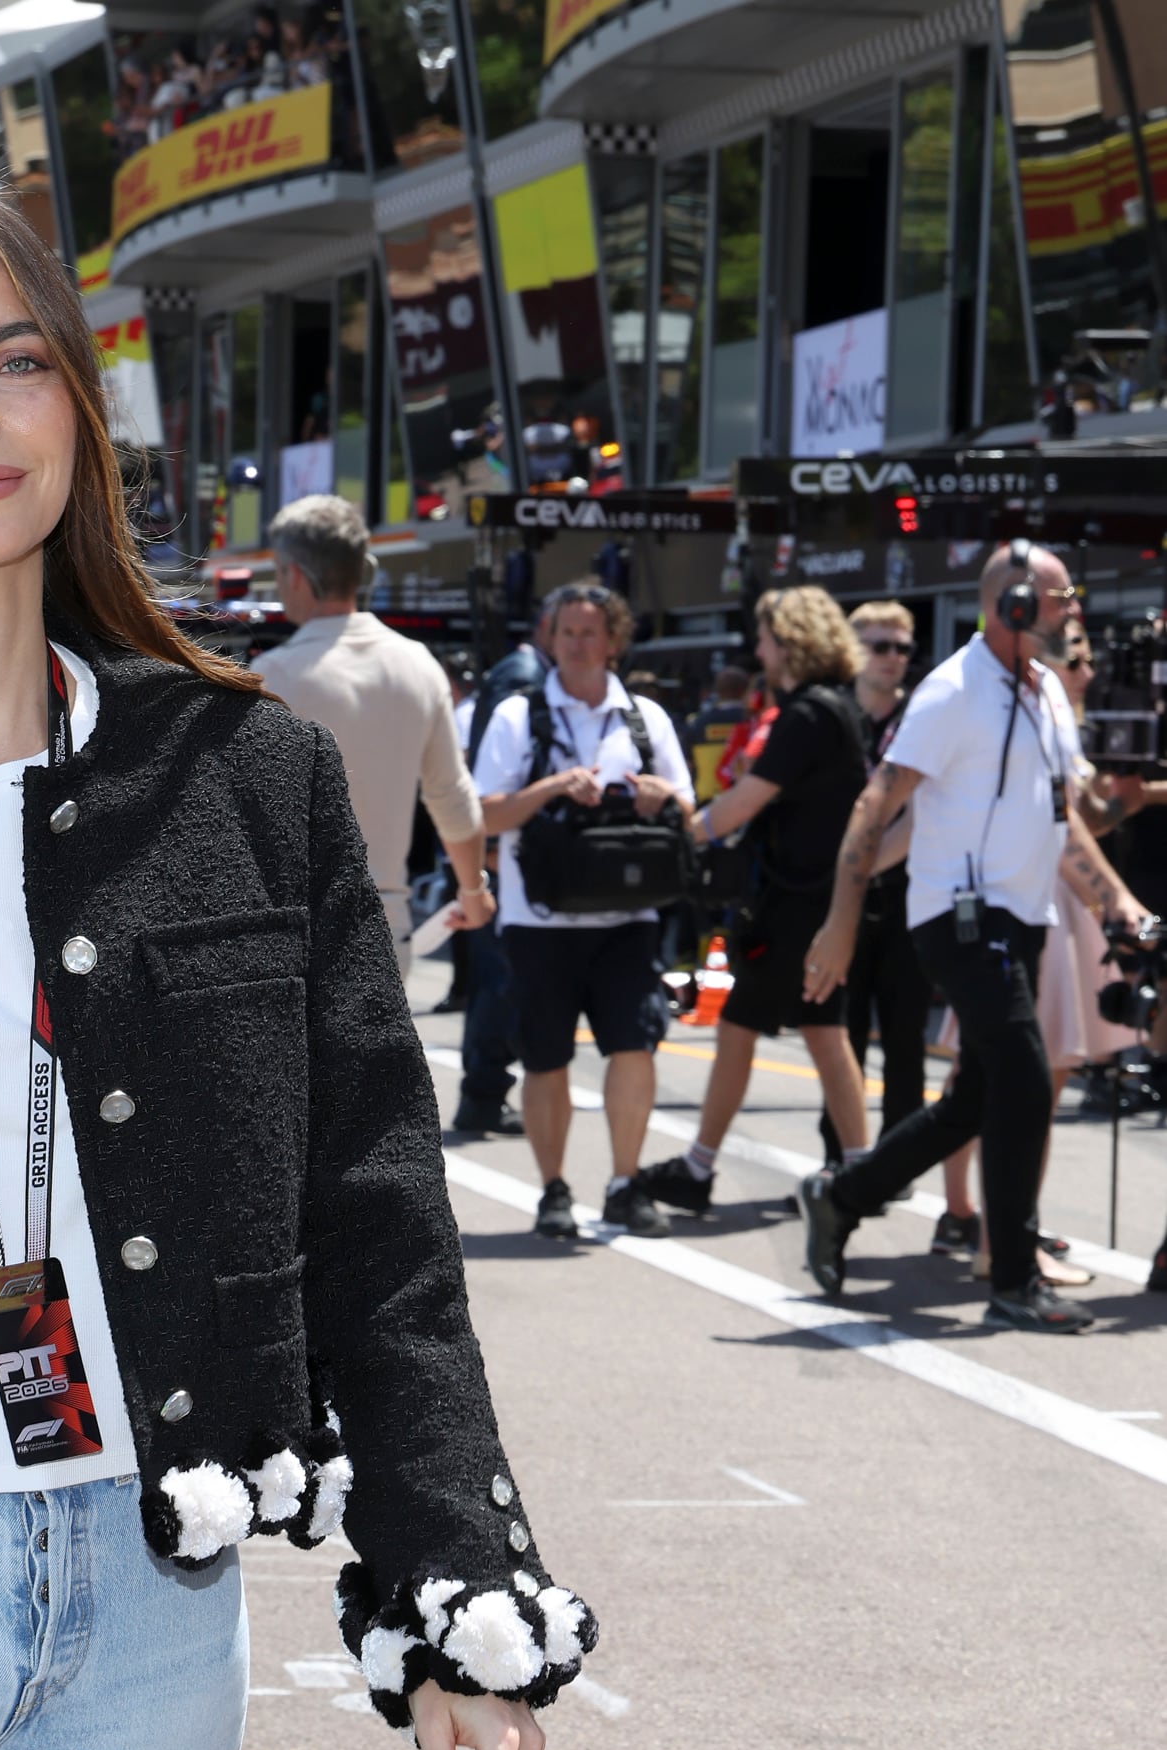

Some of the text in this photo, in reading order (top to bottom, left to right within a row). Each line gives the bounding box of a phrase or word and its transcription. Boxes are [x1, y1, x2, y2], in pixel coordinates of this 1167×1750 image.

[190, 108, 280, 184] DHL
[923, 473, 1059, 494] LOGISTIS
[609, 511, 701, 531] LOGSTICS
[31, 1062, 50, 1189] GRID ACCESS
[3, 1374, 70, 1404] 2026
[15, 1418, 65, 1444] F1
